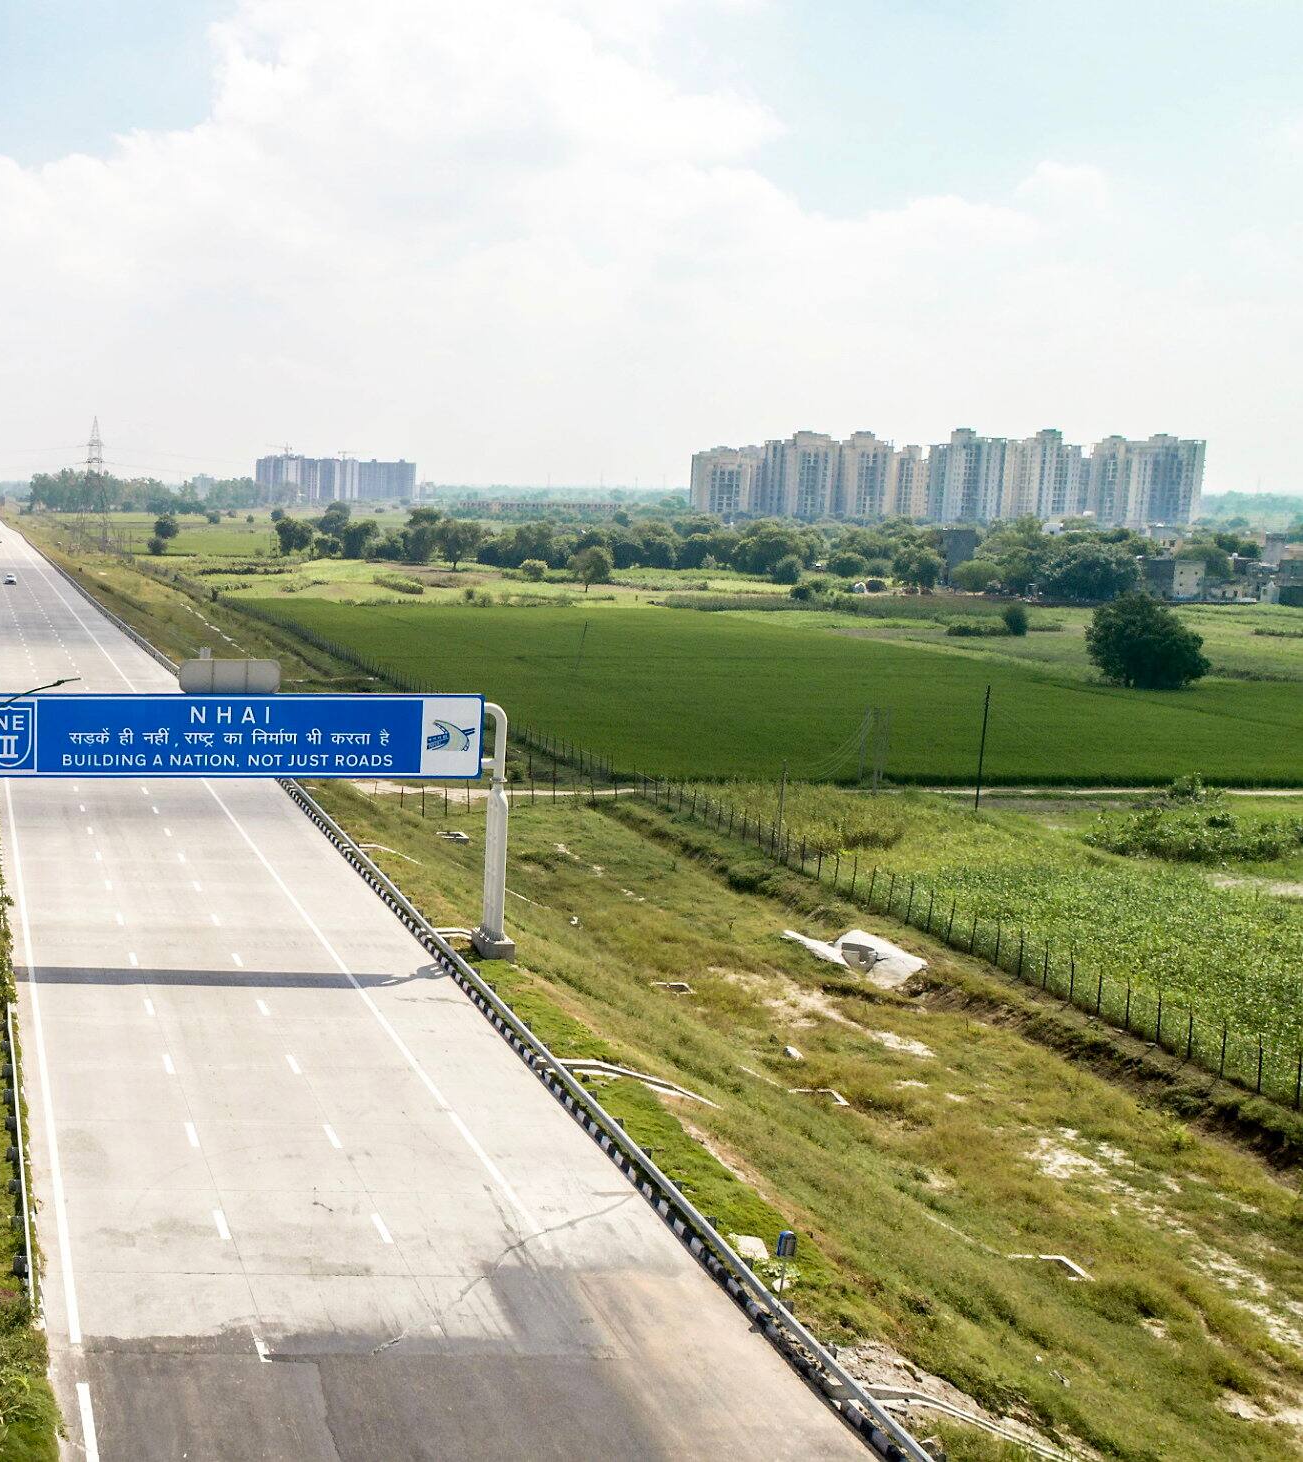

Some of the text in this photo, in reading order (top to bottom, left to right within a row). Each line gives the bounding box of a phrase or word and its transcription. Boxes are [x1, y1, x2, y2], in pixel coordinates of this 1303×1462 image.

[190, 706, 271, 724] NHAI
[0, 735, 18, 758] II
[69, 727, 110, 746] सड़कें
[118, 728, 134, 745] ही
[183, 731, 214, 748] राष्ट्र
[223, 731, 243, 745] का
[251, 728, 297, 745] निर्माण
[305, 728, 322, 745] भी
[331, 732, 371, 745] करता
[379, 728, 390, 747] है
[62, 754, 393, 768] BUILDING A NATION, NOT JUST ROADS
